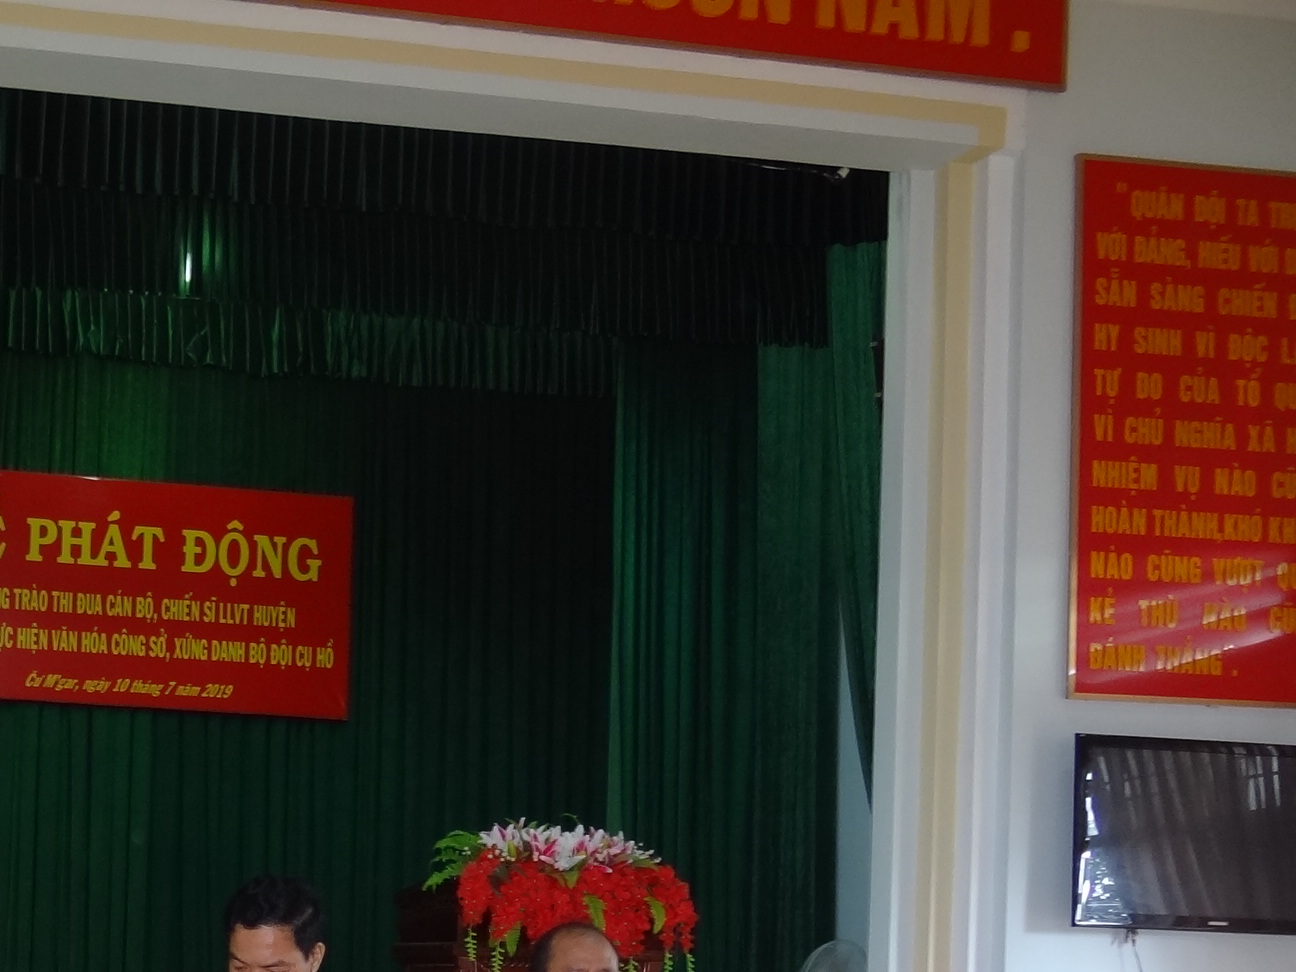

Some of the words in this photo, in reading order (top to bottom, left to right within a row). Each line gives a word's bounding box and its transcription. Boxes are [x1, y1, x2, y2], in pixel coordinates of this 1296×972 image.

[1236, 198, 1259, 226] TA
[1150, 277, 1205, 313] SÀNG
[1218, 282, 1278, 319] CHIẾN
[1094, 323, 1120, 351] HY
[1134, 327, 1182, 356] SINH
[1195, 325, 1216, 358] VÌ
[1227, 328, 1269, 368] ĐỘC
[1094, 367, 1122, 404] TỰ
[1136, 371, 1163, 400] DO
[1179, 367, 1220, 405] CỦA
[1235, 367, 1261, 408] TỔ
[1094, 408, 1114, 442] VÌ
[1124, 408, 1164, 445] CHỦ
[1175, 417, 1236, 450] NGHĨA
[1247, 420, 1275, 452] XÃ
[1092, 455, 1158, 496] NHIỆM
[1174, 464, 1201, 501] VỤ
[1214, 462, 1256, 497] NÀO
[1091, 500, 1147, 536] HOÀN
[25, 510, 165, 571] PHÁT
[181, 520, 323, 587] ĐỘNG
[1090, 545, 1134, 581] NÀO
[1146, 549, 1202, 584] CŨNG
[1213, 556, 1265, 594] VƯỢT
[13, 583, 48, 612] TRÀO
[52, 591, 73, 613] THI
[76, 593, 103, 616] ĐUA
[106, 589, 132, 617] CÁN
[135, 591, 158, 623] BỘ,
[161, 591, 200, 622] CHIẾN
[203, 597, 217, 623] SĨ
[219, 602, 250, 625] LLVT
[254, 601, 296, 632] HUYỆN
[1089, 587, 1116, 625] KẺ
[1138, 594, 1179, 628] THÙ
[1203, 597, 1246, 632] NÀO
[17, 622, 49, 654] HIỆN
[52, 626, 78, 652] VĂN
[81, 626, 109, 655] HÓA
[111, 628, 146, 657] CÔNG
[149, 628, 170, 662] SỞ,
[173, 632, 208, 661] XỨNG
[211, 640, 245, 663] DANH
[249, 637, 267, 669] BỘ
[270, 639, 293, 670] ĐỘI
[295, 645, 312, 672] CỤ
[316, 638, 334, 669] HỒ
[1089, 636, 1146, 672] ĐÁNH
[82, 676, 111, 694] ngày
[112, 678, 130, 692] 10
[130, 680, 164, 697] tháng
[165, 681, 177, 695] 7
[175, 683, 201, 697] năm
[201, 683, 234, 699] 2019
